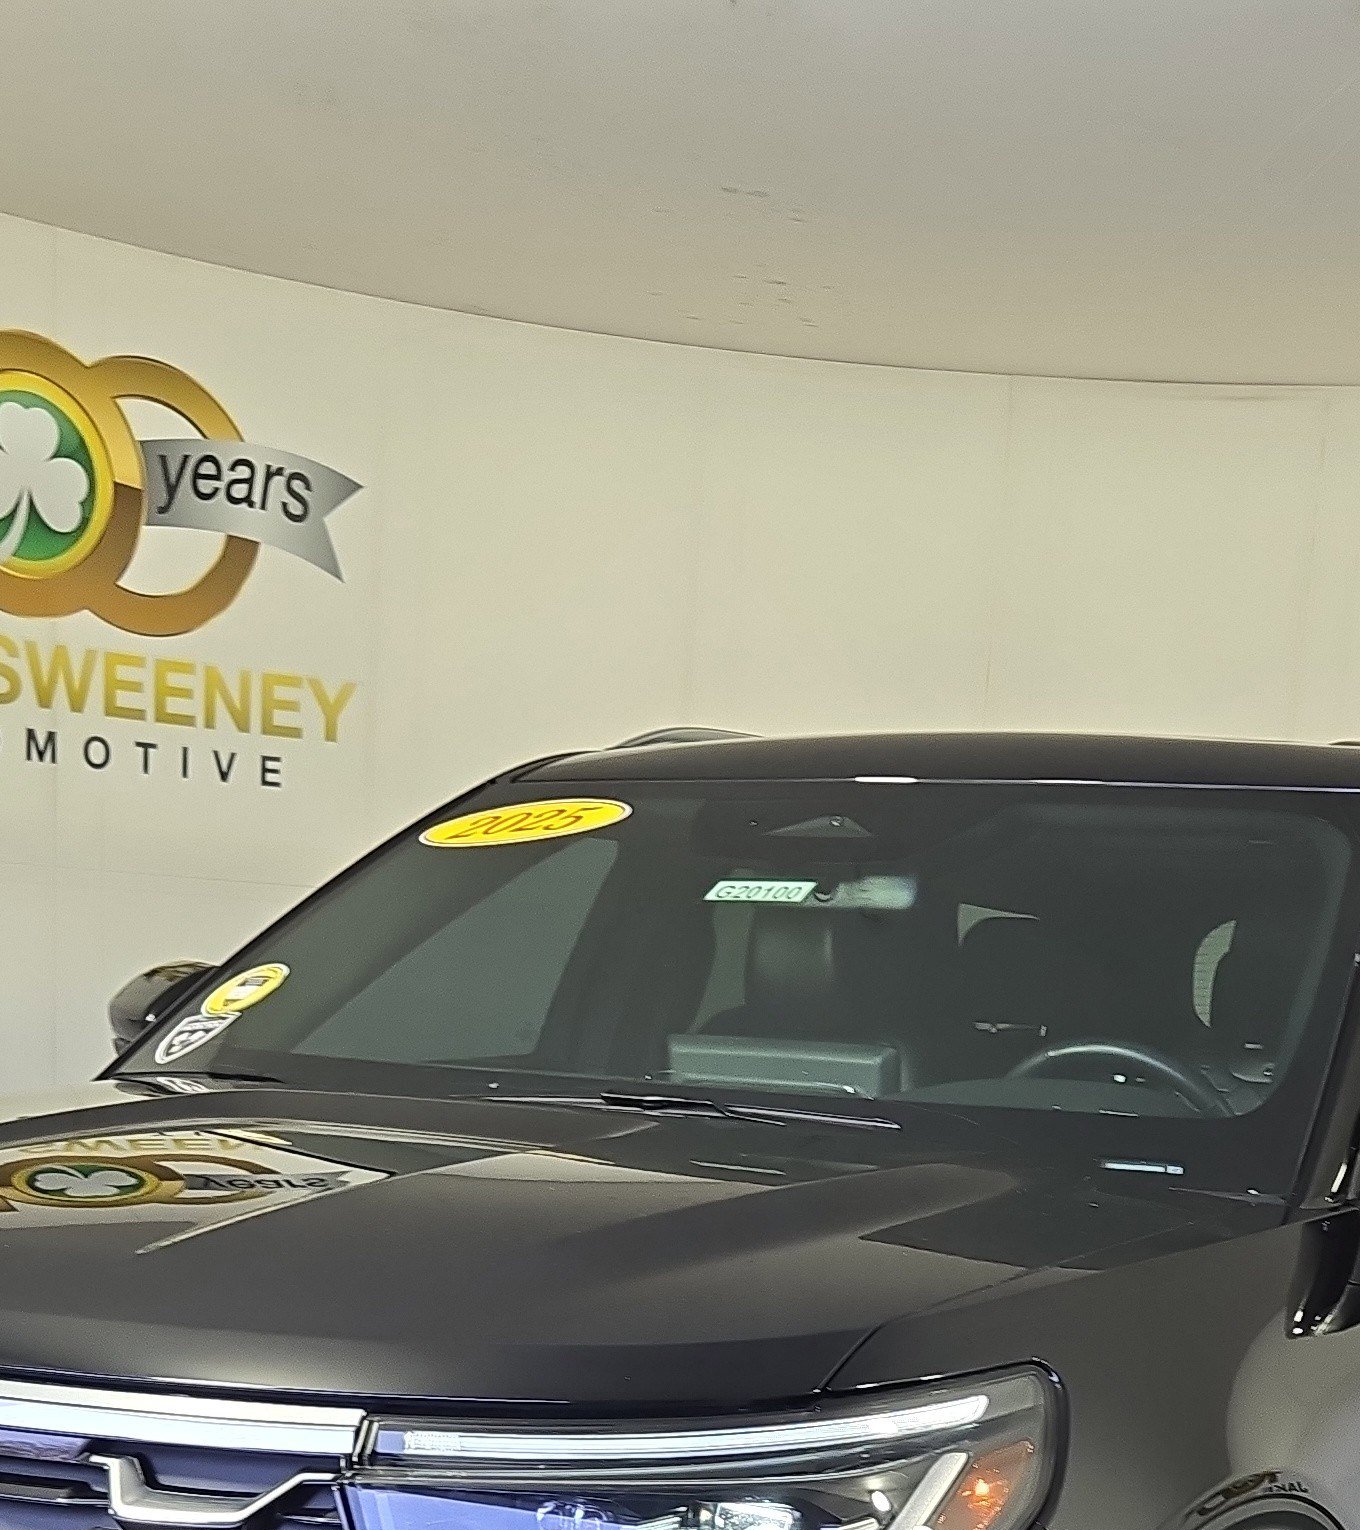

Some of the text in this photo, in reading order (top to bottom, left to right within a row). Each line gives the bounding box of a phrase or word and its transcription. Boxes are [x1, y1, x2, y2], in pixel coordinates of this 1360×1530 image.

[156, 452, 313, 523] years
[443, 806, 604, 840] 2025
[715, 884, 803, 899] G20100
